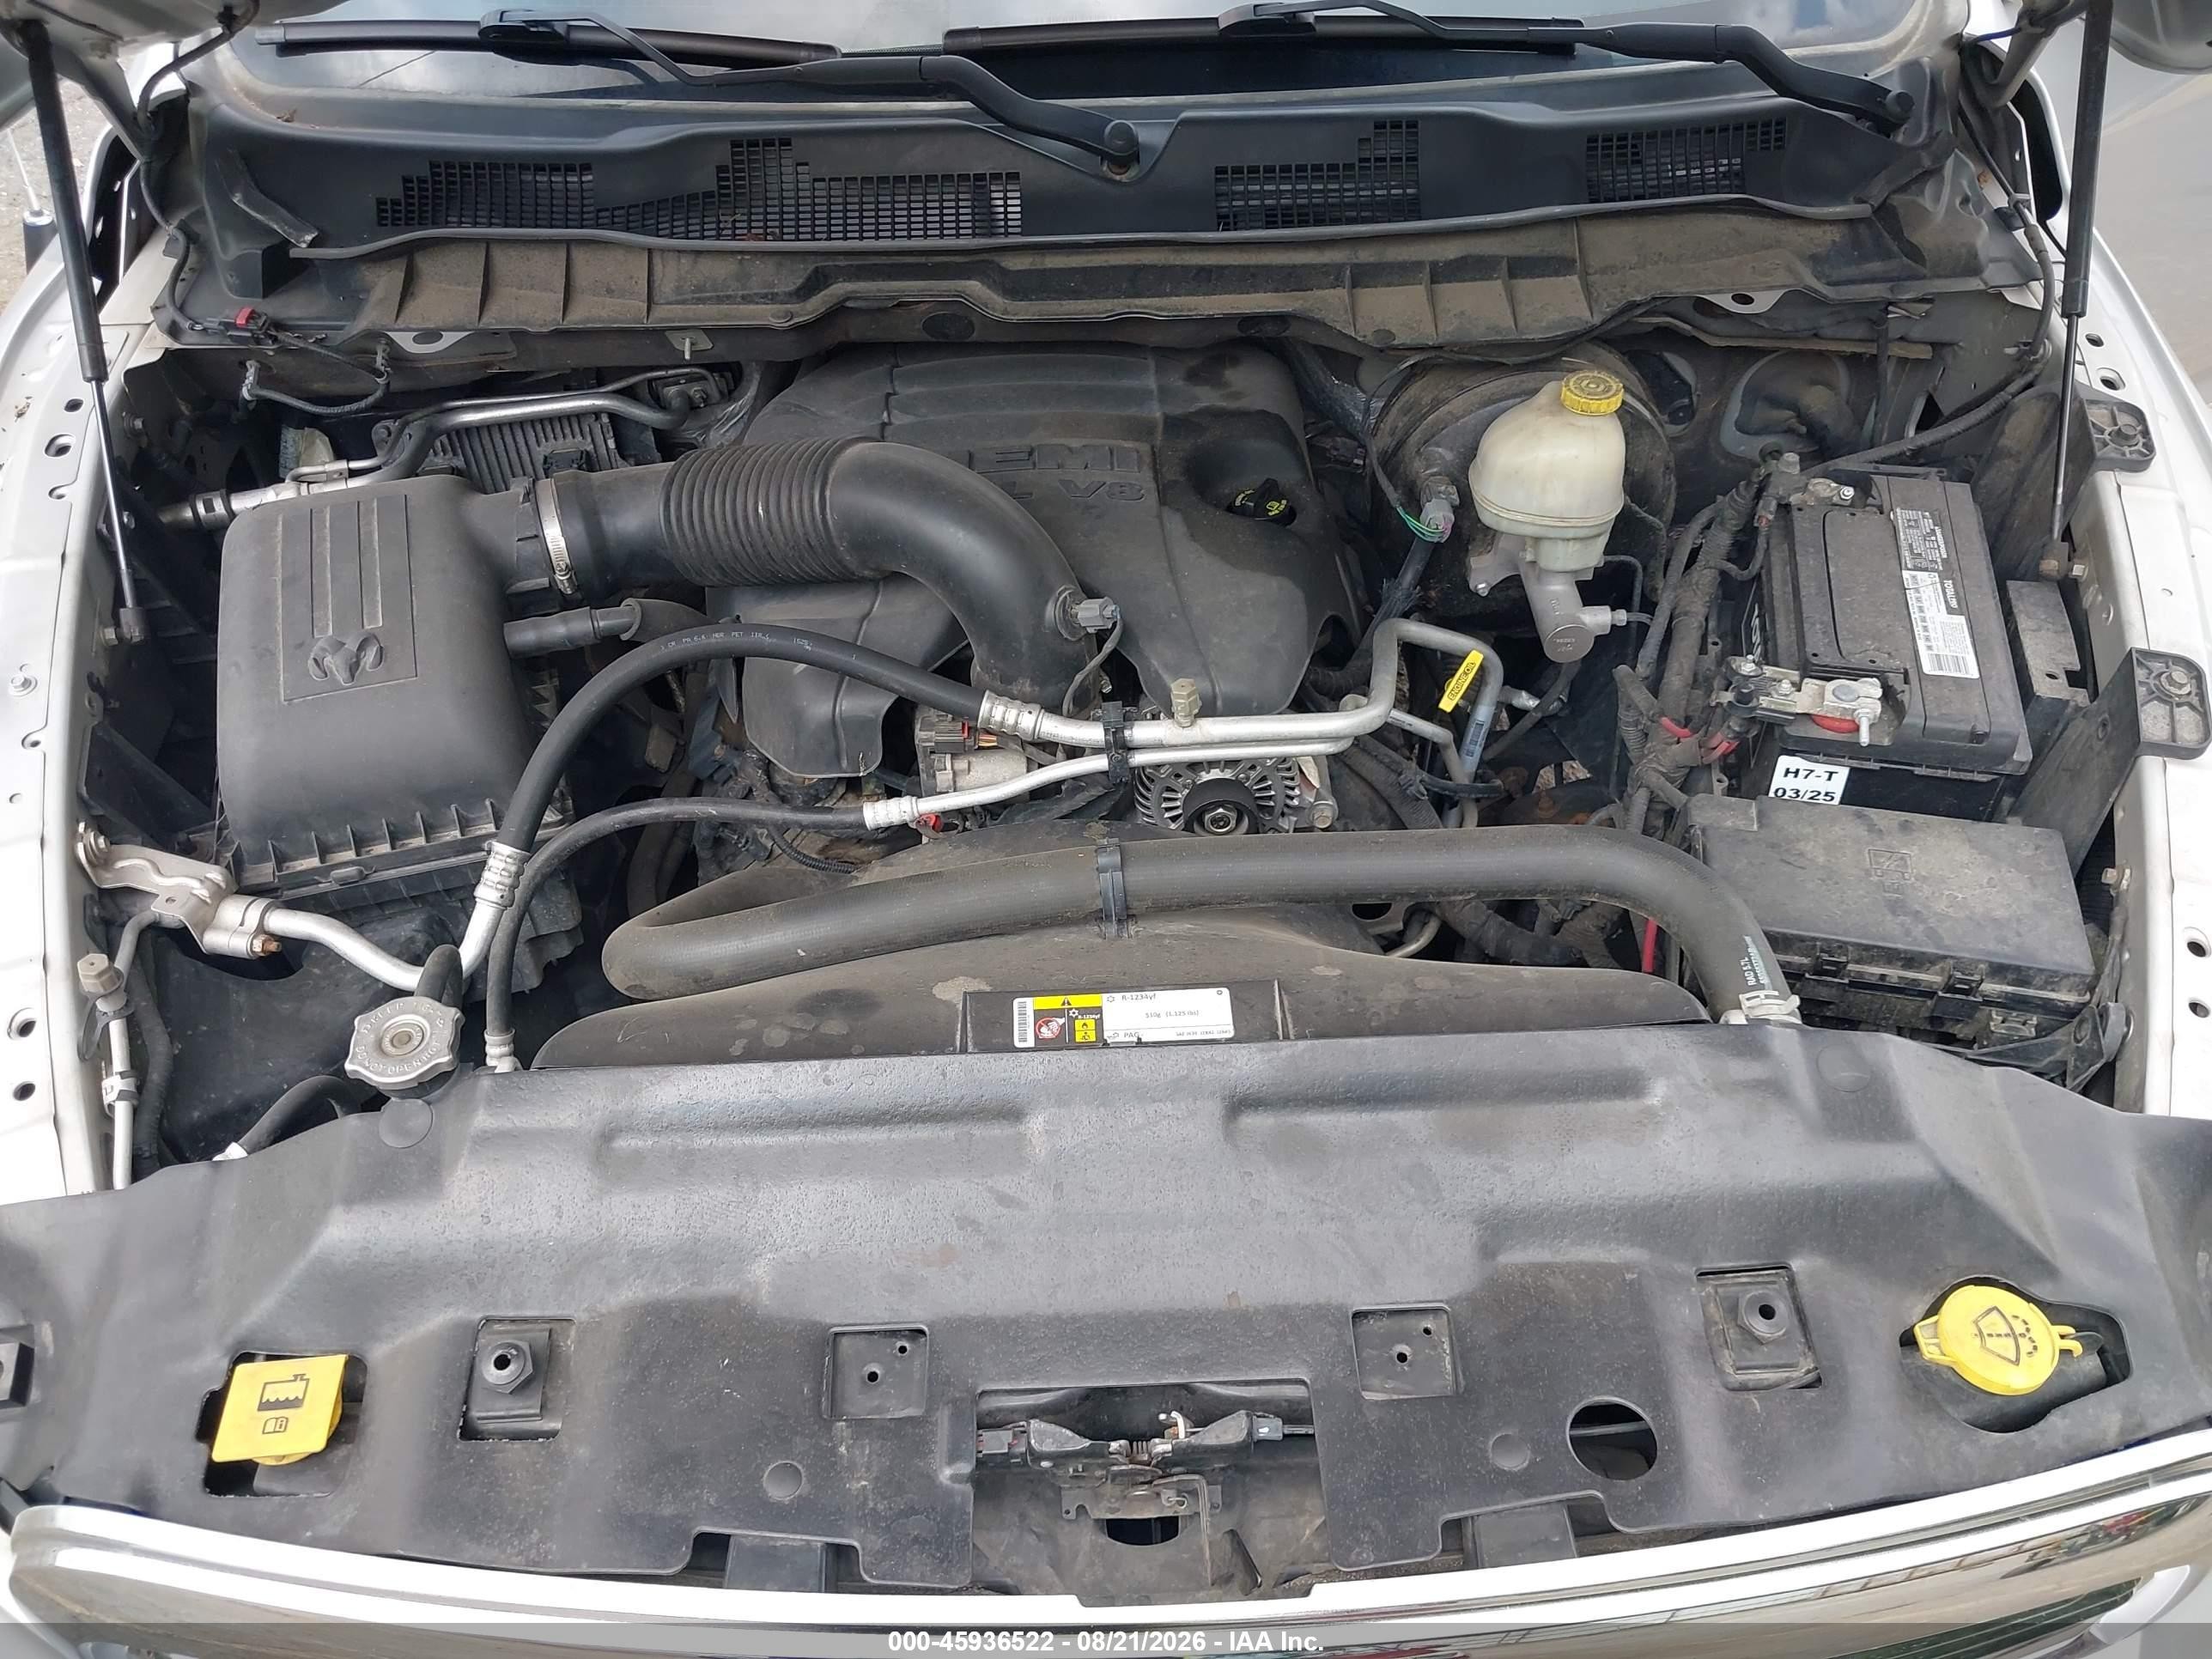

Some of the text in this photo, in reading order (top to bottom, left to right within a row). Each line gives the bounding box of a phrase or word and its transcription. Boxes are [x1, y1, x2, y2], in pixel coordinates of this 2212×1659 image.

[960, 443, 1141, 474] EMI
[1057, 478, 1146, 502] V8
[1448, 662, 1476, 701] ENGINE OIL
[1783, 767, 1839, 781] H7-T
[1773, 787, 1836, 802] 03/25
[1121, 993, 1157, 1001] R-1234yf
[386, 1057, 422, 1074] OPEN
